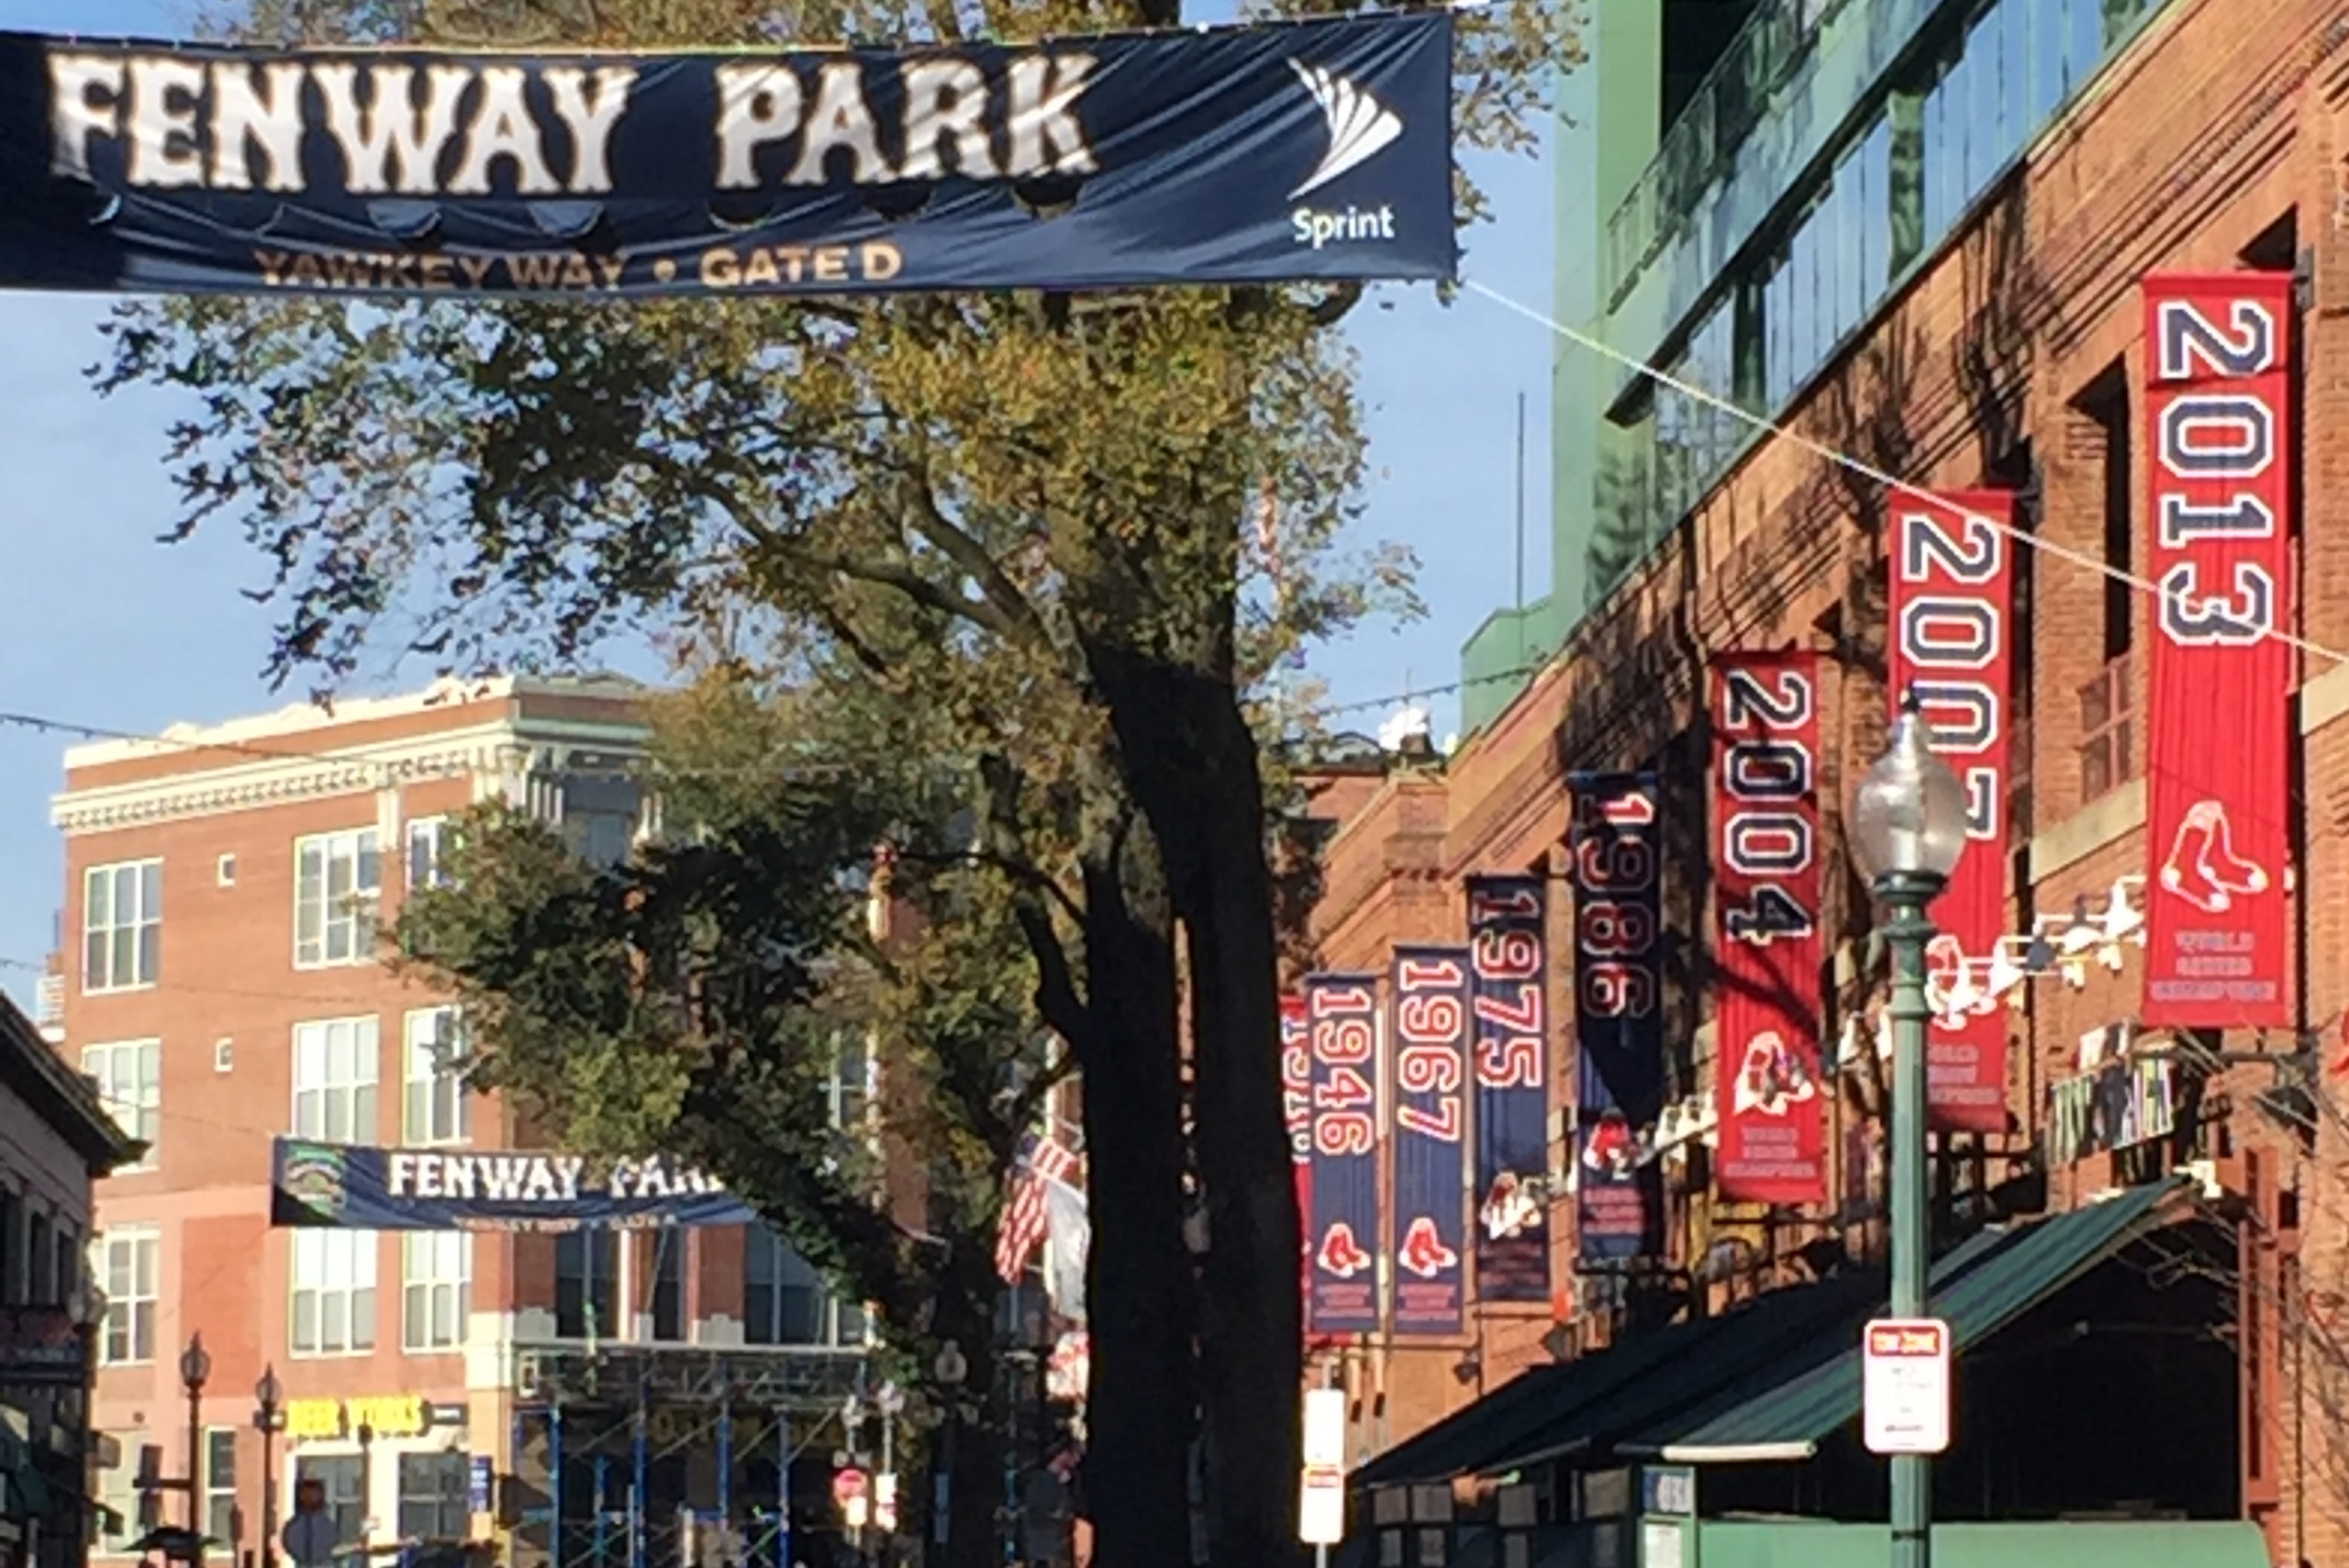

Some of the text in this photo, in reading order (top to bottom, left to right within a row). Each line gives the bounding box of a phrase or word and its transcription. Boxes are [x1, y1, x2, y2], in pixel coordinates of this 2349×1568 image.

[49, 53, 1099, 195] FENWAY PARK
[255, 242, 902, 293] YAWKEY WAY GATE D
[1292, 206, 1396, 250] Sprint
[2157, 298, 2274, 646] 2013
[1724, 670, 1812, 946] 2004
[1472, 890, 1542, 1088] 1975
[1577, 793, 1655, 1019] 1986
[1313, 986, 1374, 1156] 1946
[1397, 960, 1464, 1142] 1967
[389, 1153, 584, 1201] FENWAY
